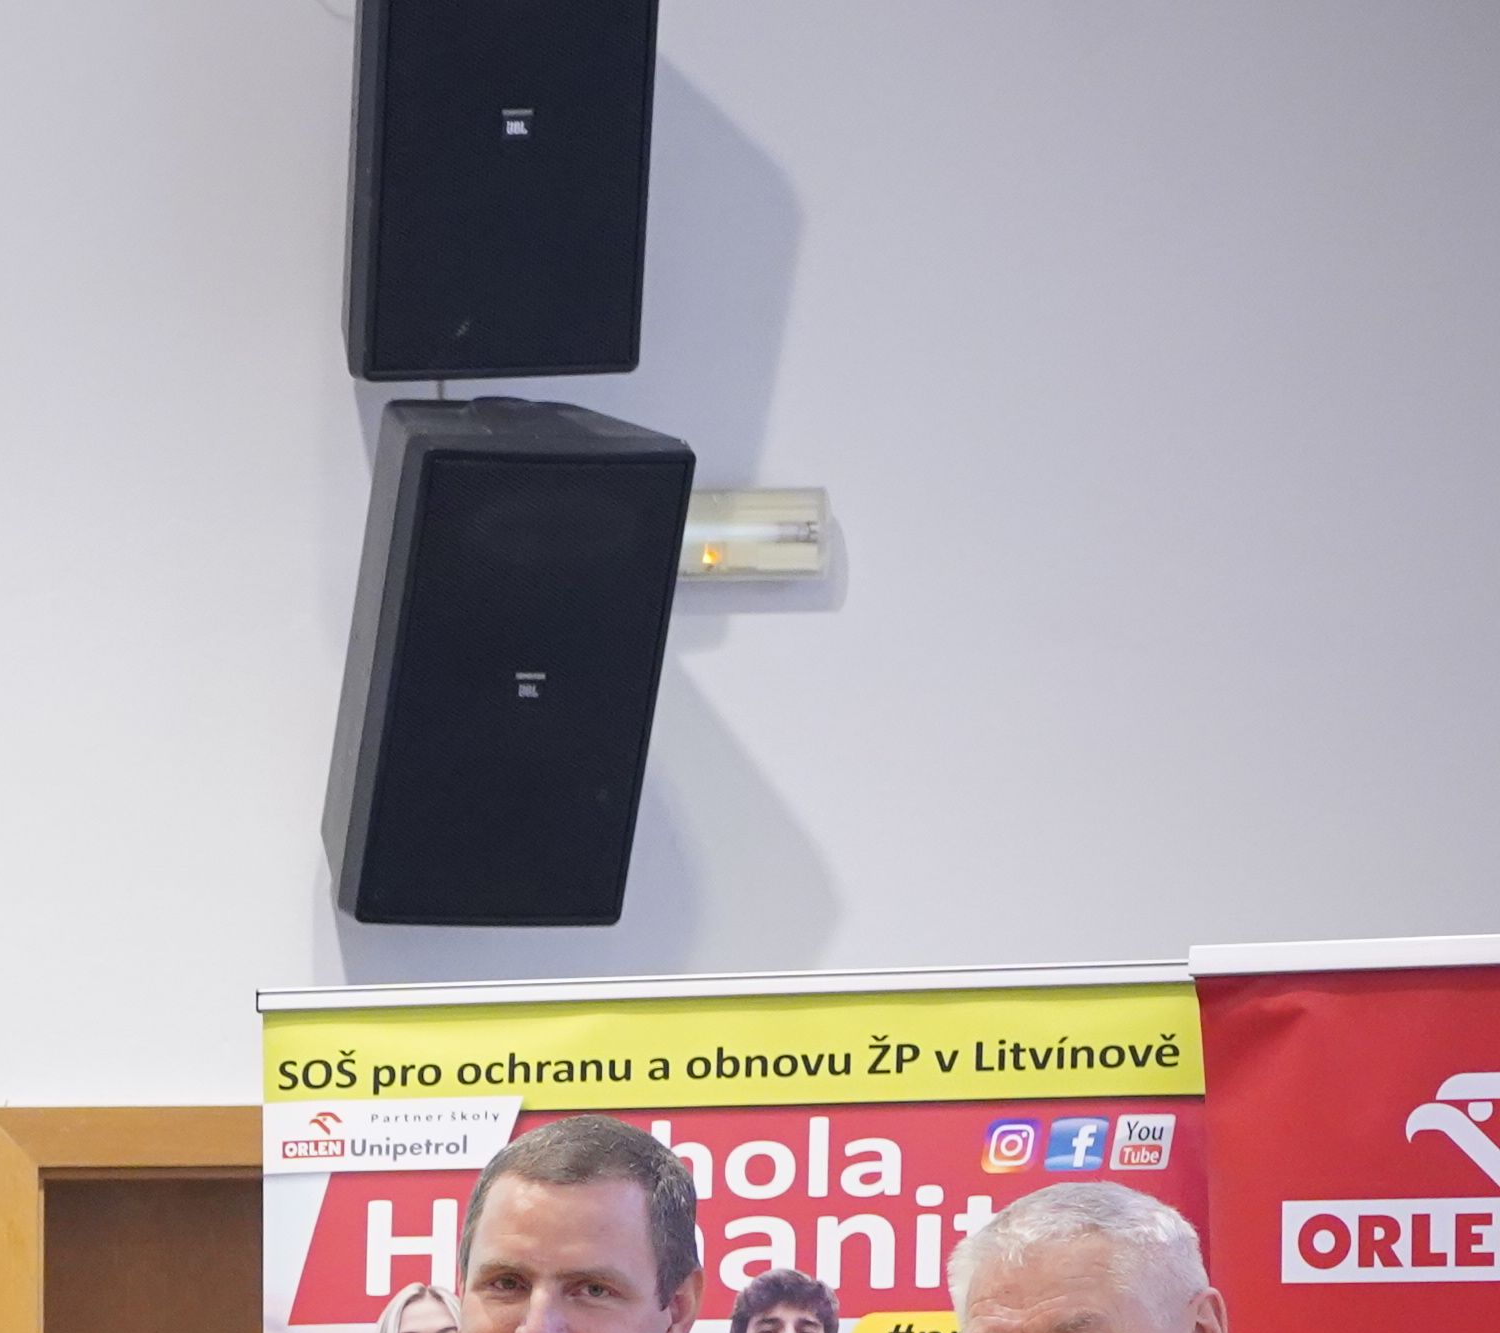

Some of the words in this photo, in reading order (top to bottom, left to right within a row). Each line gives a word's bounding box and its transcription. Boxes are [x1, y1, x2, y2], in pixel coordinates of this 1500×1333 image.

[278, 1050, 357, 1091] SOŠ
[373, 1059, 441, 1095] pro
[456, 1052, 631, 1086] ochranu
[648, 1056, 670, 1080] a
[686, 1047, 851, 1079] obnovu
[868, 1036, 920, 1073] ŽP
[935, 1050, 958, 1072] v
[975, 1033, 1180, 1071] Litvínově
[371, 1113, 443, 1123] Partner
[450, 1109, 500, 1123] školy
[1127, 1122, 1163, 1142] You
[283, 1140, 343, 1158] ORLEN
[350, 1135, 468, 1161] Unipetrol
[650, 1116, 902, 1199] hola
[1122, 1146, 1160, 1164] Tube
[1298, 1213, 1494, 1269] ORLE
